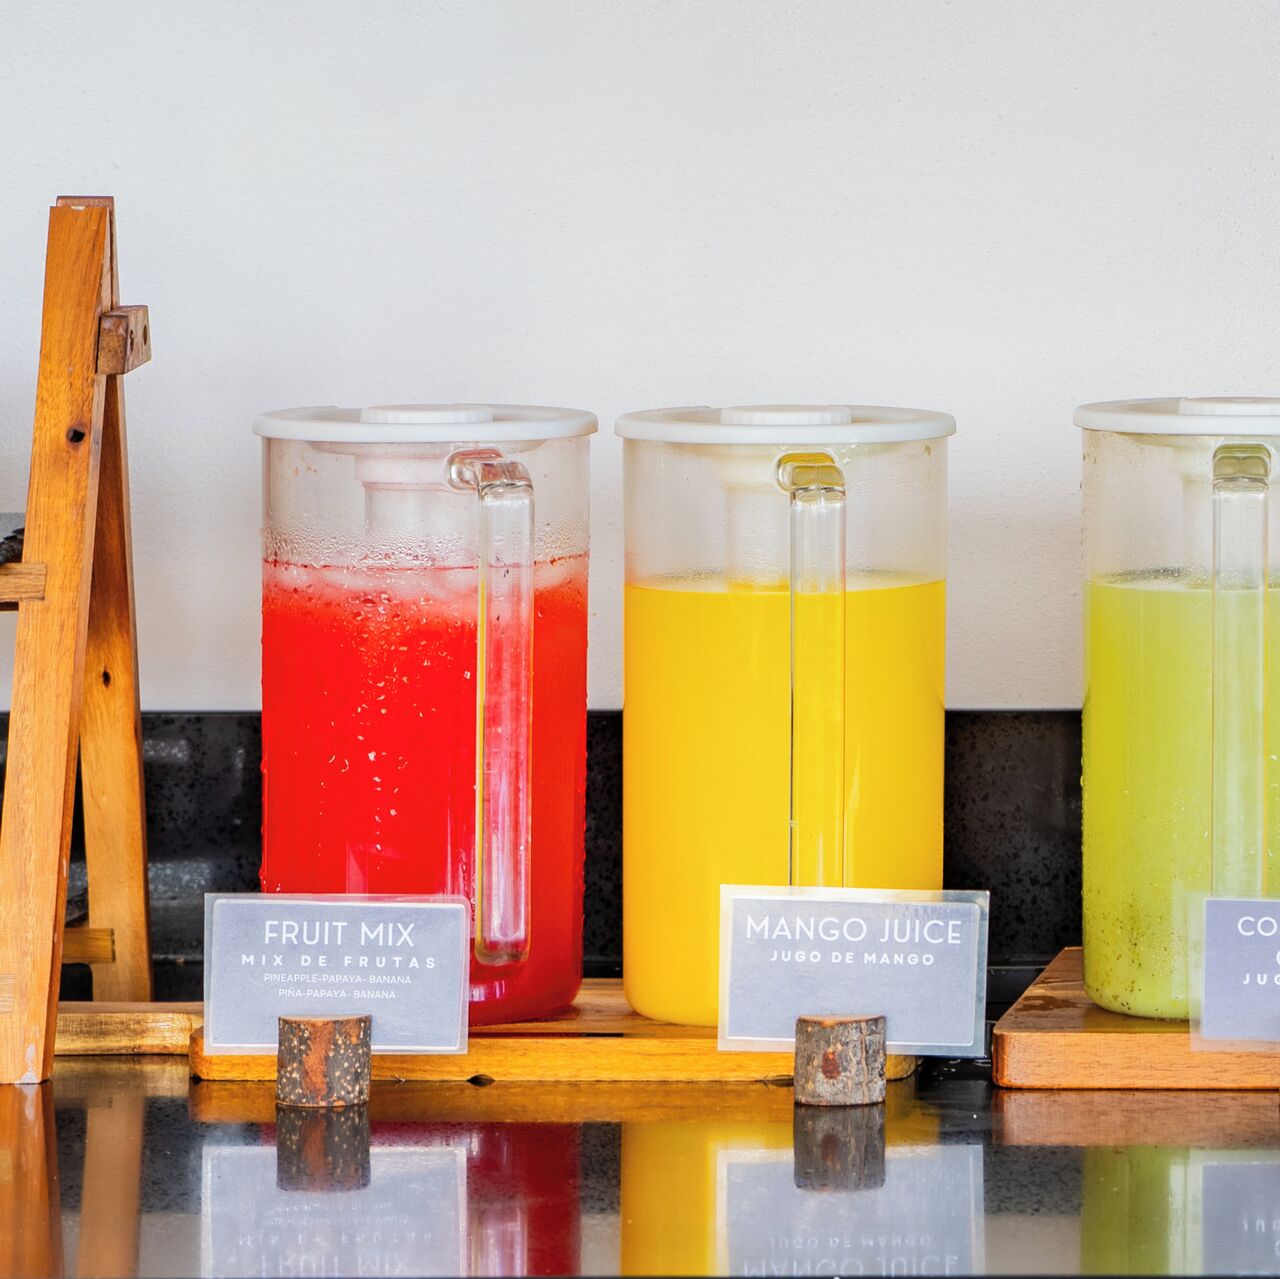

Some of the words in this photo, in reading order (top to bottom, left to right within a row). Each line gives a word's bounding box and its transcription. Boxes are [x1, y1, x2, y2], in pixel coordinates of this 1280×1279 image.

[265, 920, 347, 946] FRUIT
[361, 922, 415, 947] MIX
[746, 914, 868, 942] MANGO
[879, 918, 962, 945] JUICE
[242, 954, 284, 966] MIX
[301, 956, 327, 967] DE
[344, 956, 436, 968] FRUTAS
[770, 950, 821, 962] JUGO
[832, 952, 854, 963] DE
[864, 953, 934, 965] MANGO
[369, 975, 412, 984] BANANA
[353, 990, 396, 999] BANANA
